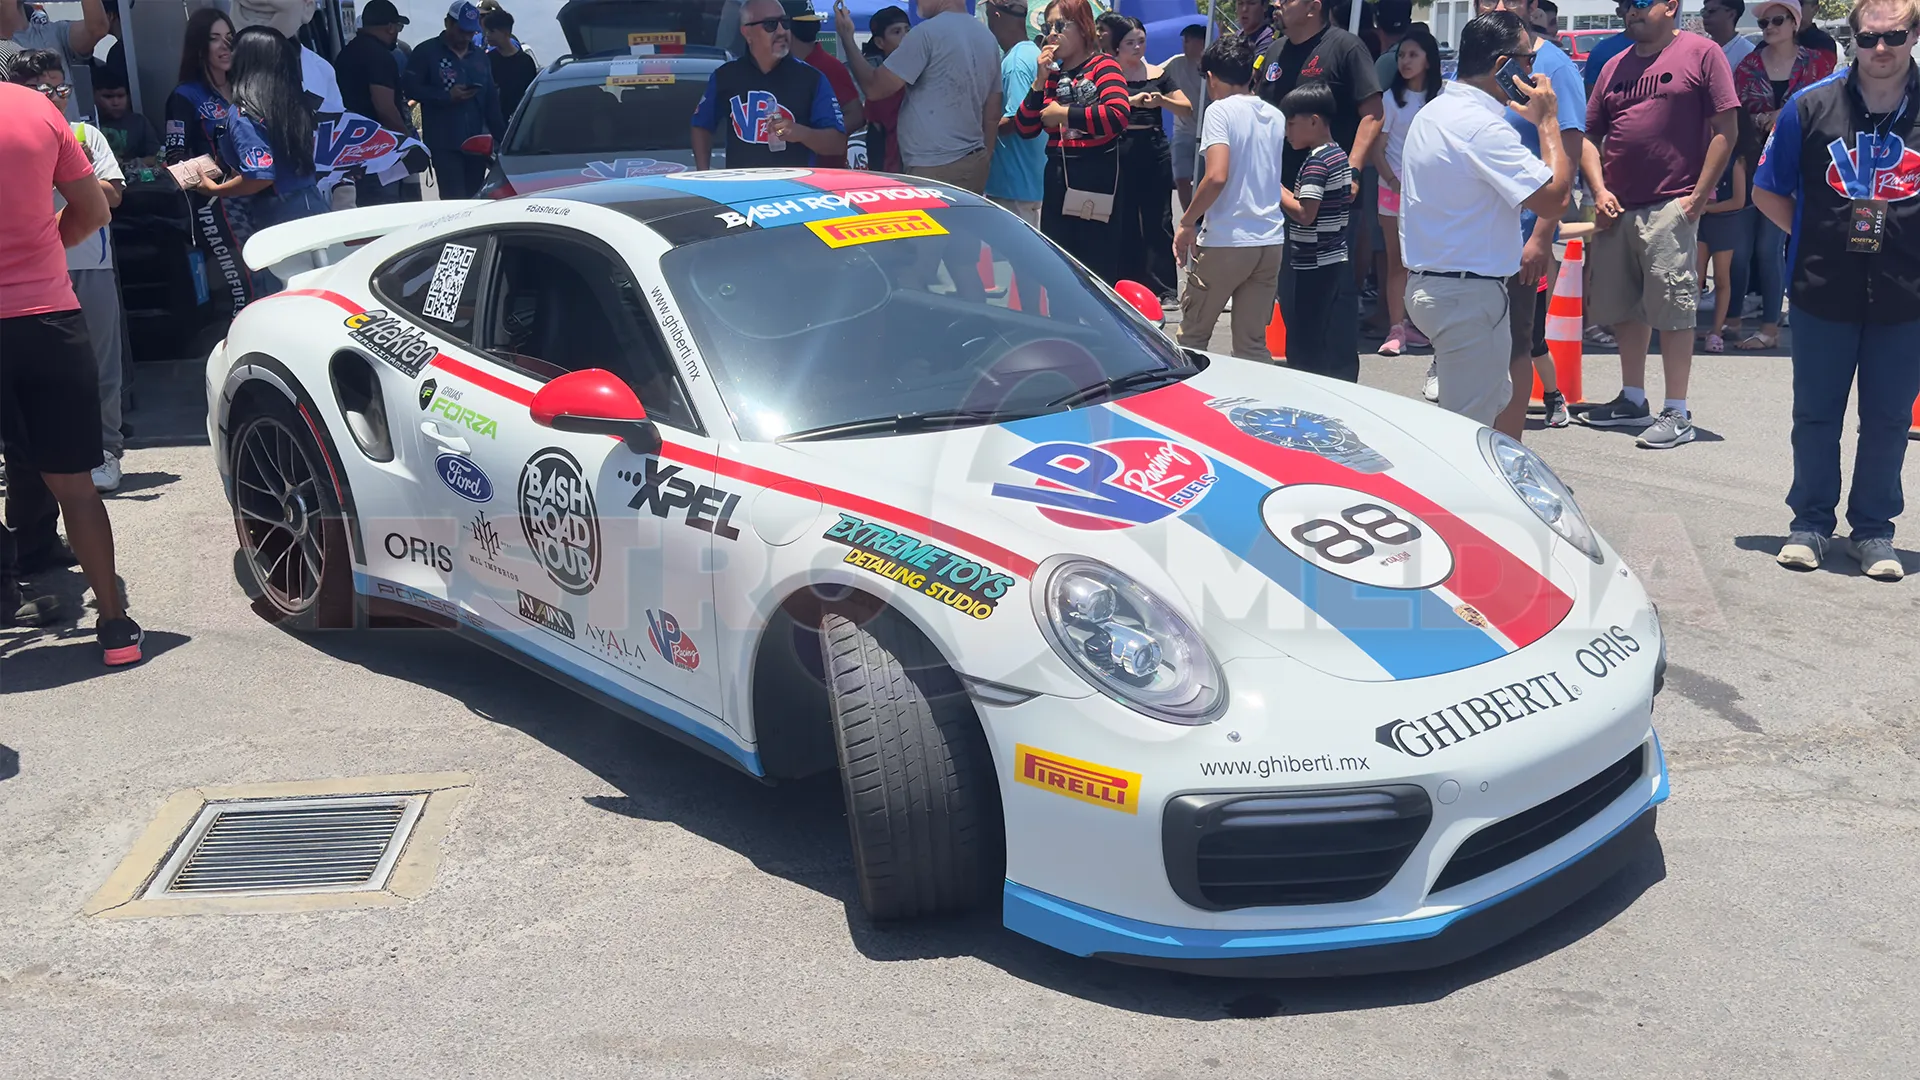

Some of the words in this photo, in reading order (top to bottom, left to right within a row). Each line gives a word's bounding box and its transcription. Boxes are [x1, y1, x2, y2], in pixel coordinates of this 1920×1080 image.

[315, 119, 381, 166] VP
[730, 91, 777, 143] VP
[1827, 131, 1905, 199] VP
[714, 200, 803, 229] BASH
[798, 191, 879, 211] ROAD
[875, 187, 957, 202] TOUR
[823, 215, 932, 241] PIRELLI
[1874, 210, 1884, 234] STAFF
[651, 286, 701, 382] www.ghiberti.mx
[430, 397, 498, 440] FORZA
[441, 386, 463, 401] GRUAS
[446, 459, 481, 497] Ford
[526, 463, 589, 515] BASH
[991, 443, 1178, 524] VP
[1124, 443, 1192, 499] Racing
[1169, 474, 1219, 506] FUELS
[526, 497, 591, 549] ROAD
[627, 458, 741, 541] XPEL
[385, 532, 454, 574] ORIS
[532, 529, 593, 580] TOUR
[827, 514, 946, 570] EXTREME
[937, 556, 1014, 599] TOYS
[1291, 503, 1422, 564] 88
[377, 583, 486, 632] PORSCHE
[845, 549, 926, 589] DETAILING
[925, 582, 992, 620] STUDIO
[585, 623, 646, 662] AYALA
[645, 609, 681, 666] VP
[673, 645, 699, 663] Racing
[1396, 671, 1578, 758] GHIBERTI
[1575, 625, 1640, 678] ORIS
[1024, 753, 1128, 805] PIRELLI
[1200, 754, 1370, 779] www.ghiberti.mx
